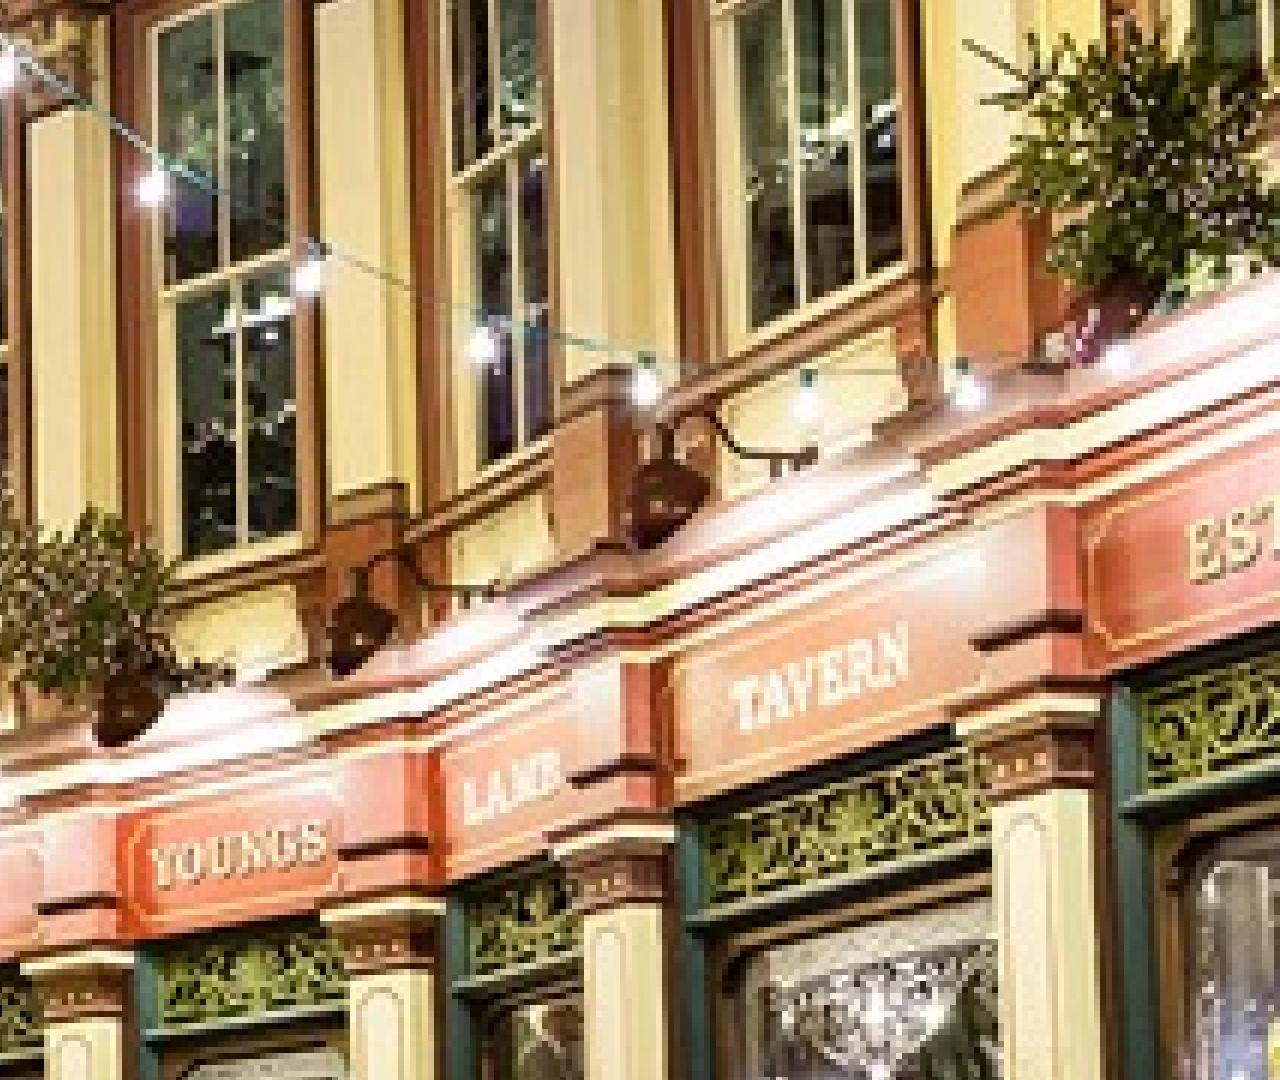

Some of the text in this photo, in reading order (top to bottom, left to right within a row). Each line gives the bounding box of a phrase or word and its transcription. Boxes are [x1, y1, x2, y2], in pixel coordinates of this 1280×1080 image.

[727, 622, 911, 731] TAVERN
[461, 751, 562, 826] LAMB
[151, 801, 331, 872] YOUNGS
